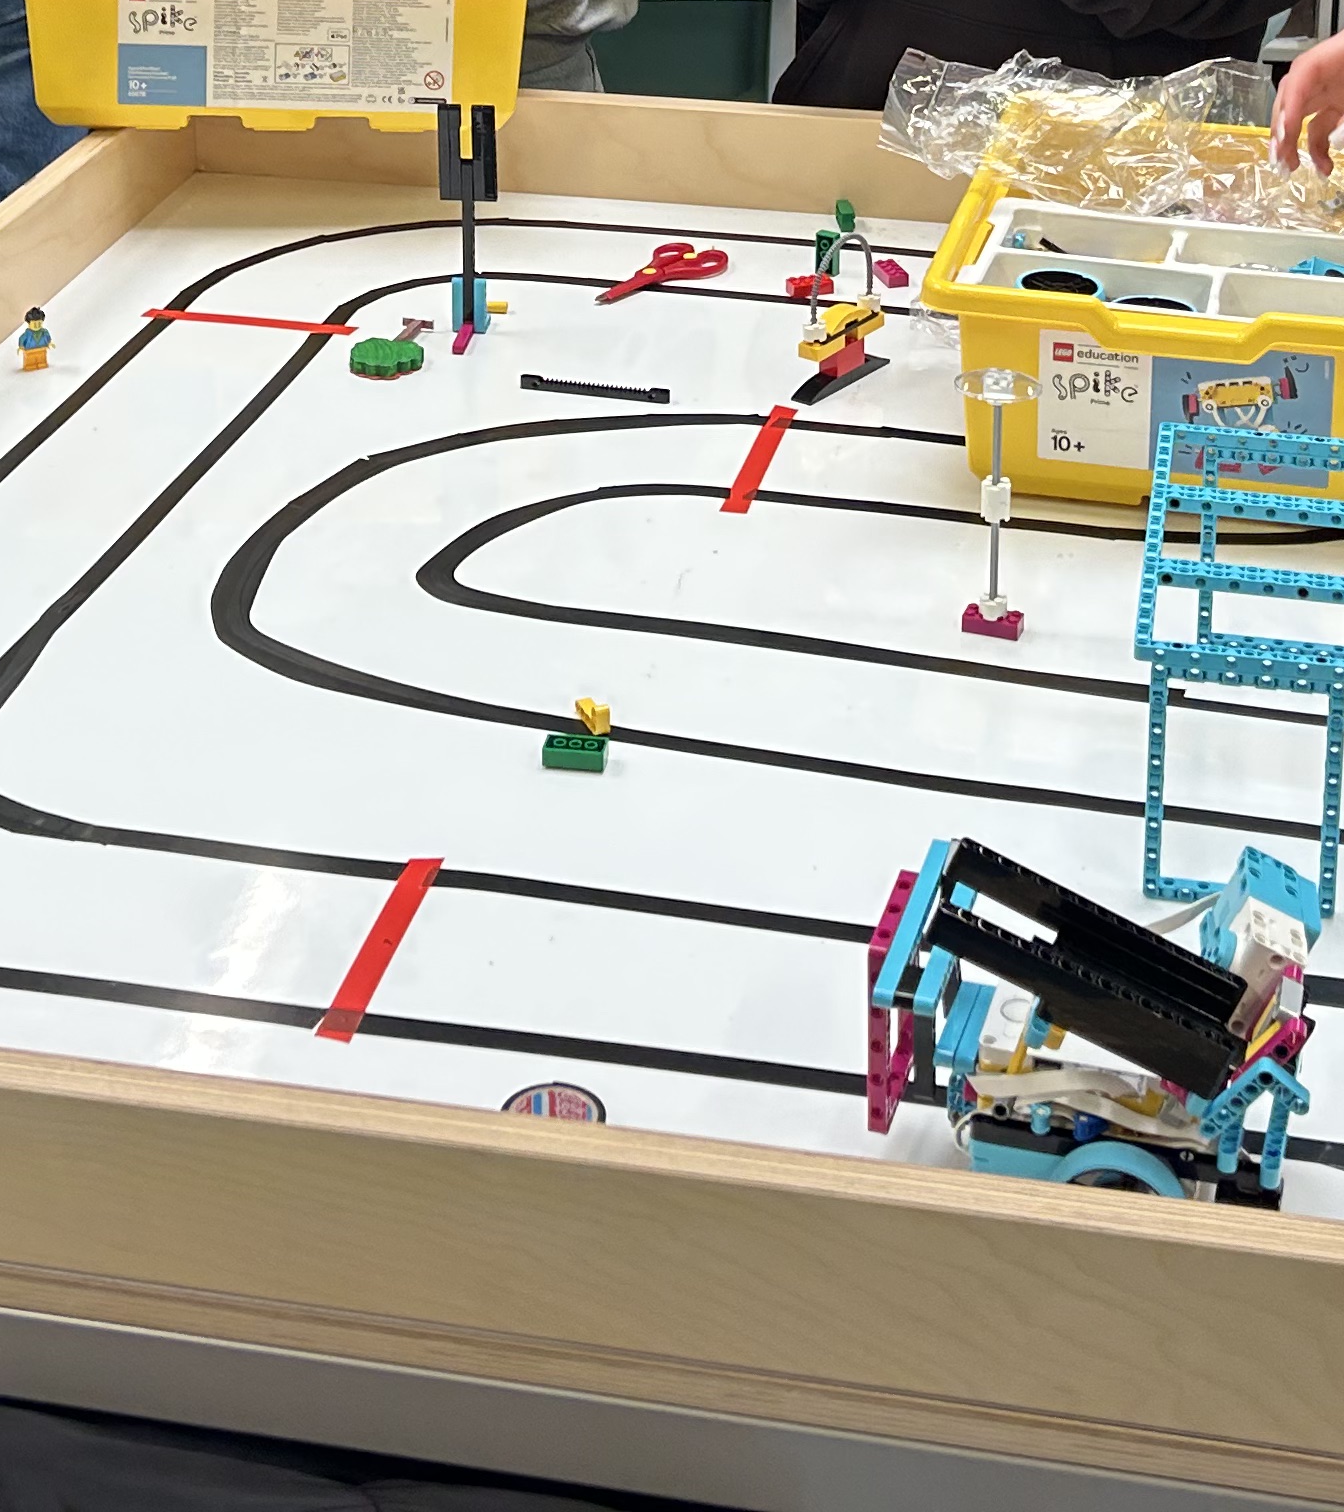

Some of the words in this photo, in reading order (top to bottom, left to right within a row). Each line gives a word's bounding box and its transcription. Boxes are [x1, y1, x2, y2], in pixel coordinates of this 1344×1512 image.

[128, 4, 198, 34] spike
[1076, 348, 1139, 364] education
[1052, 369, 1139, 403] spike
[1051, 434, 1086, 453] 10+
